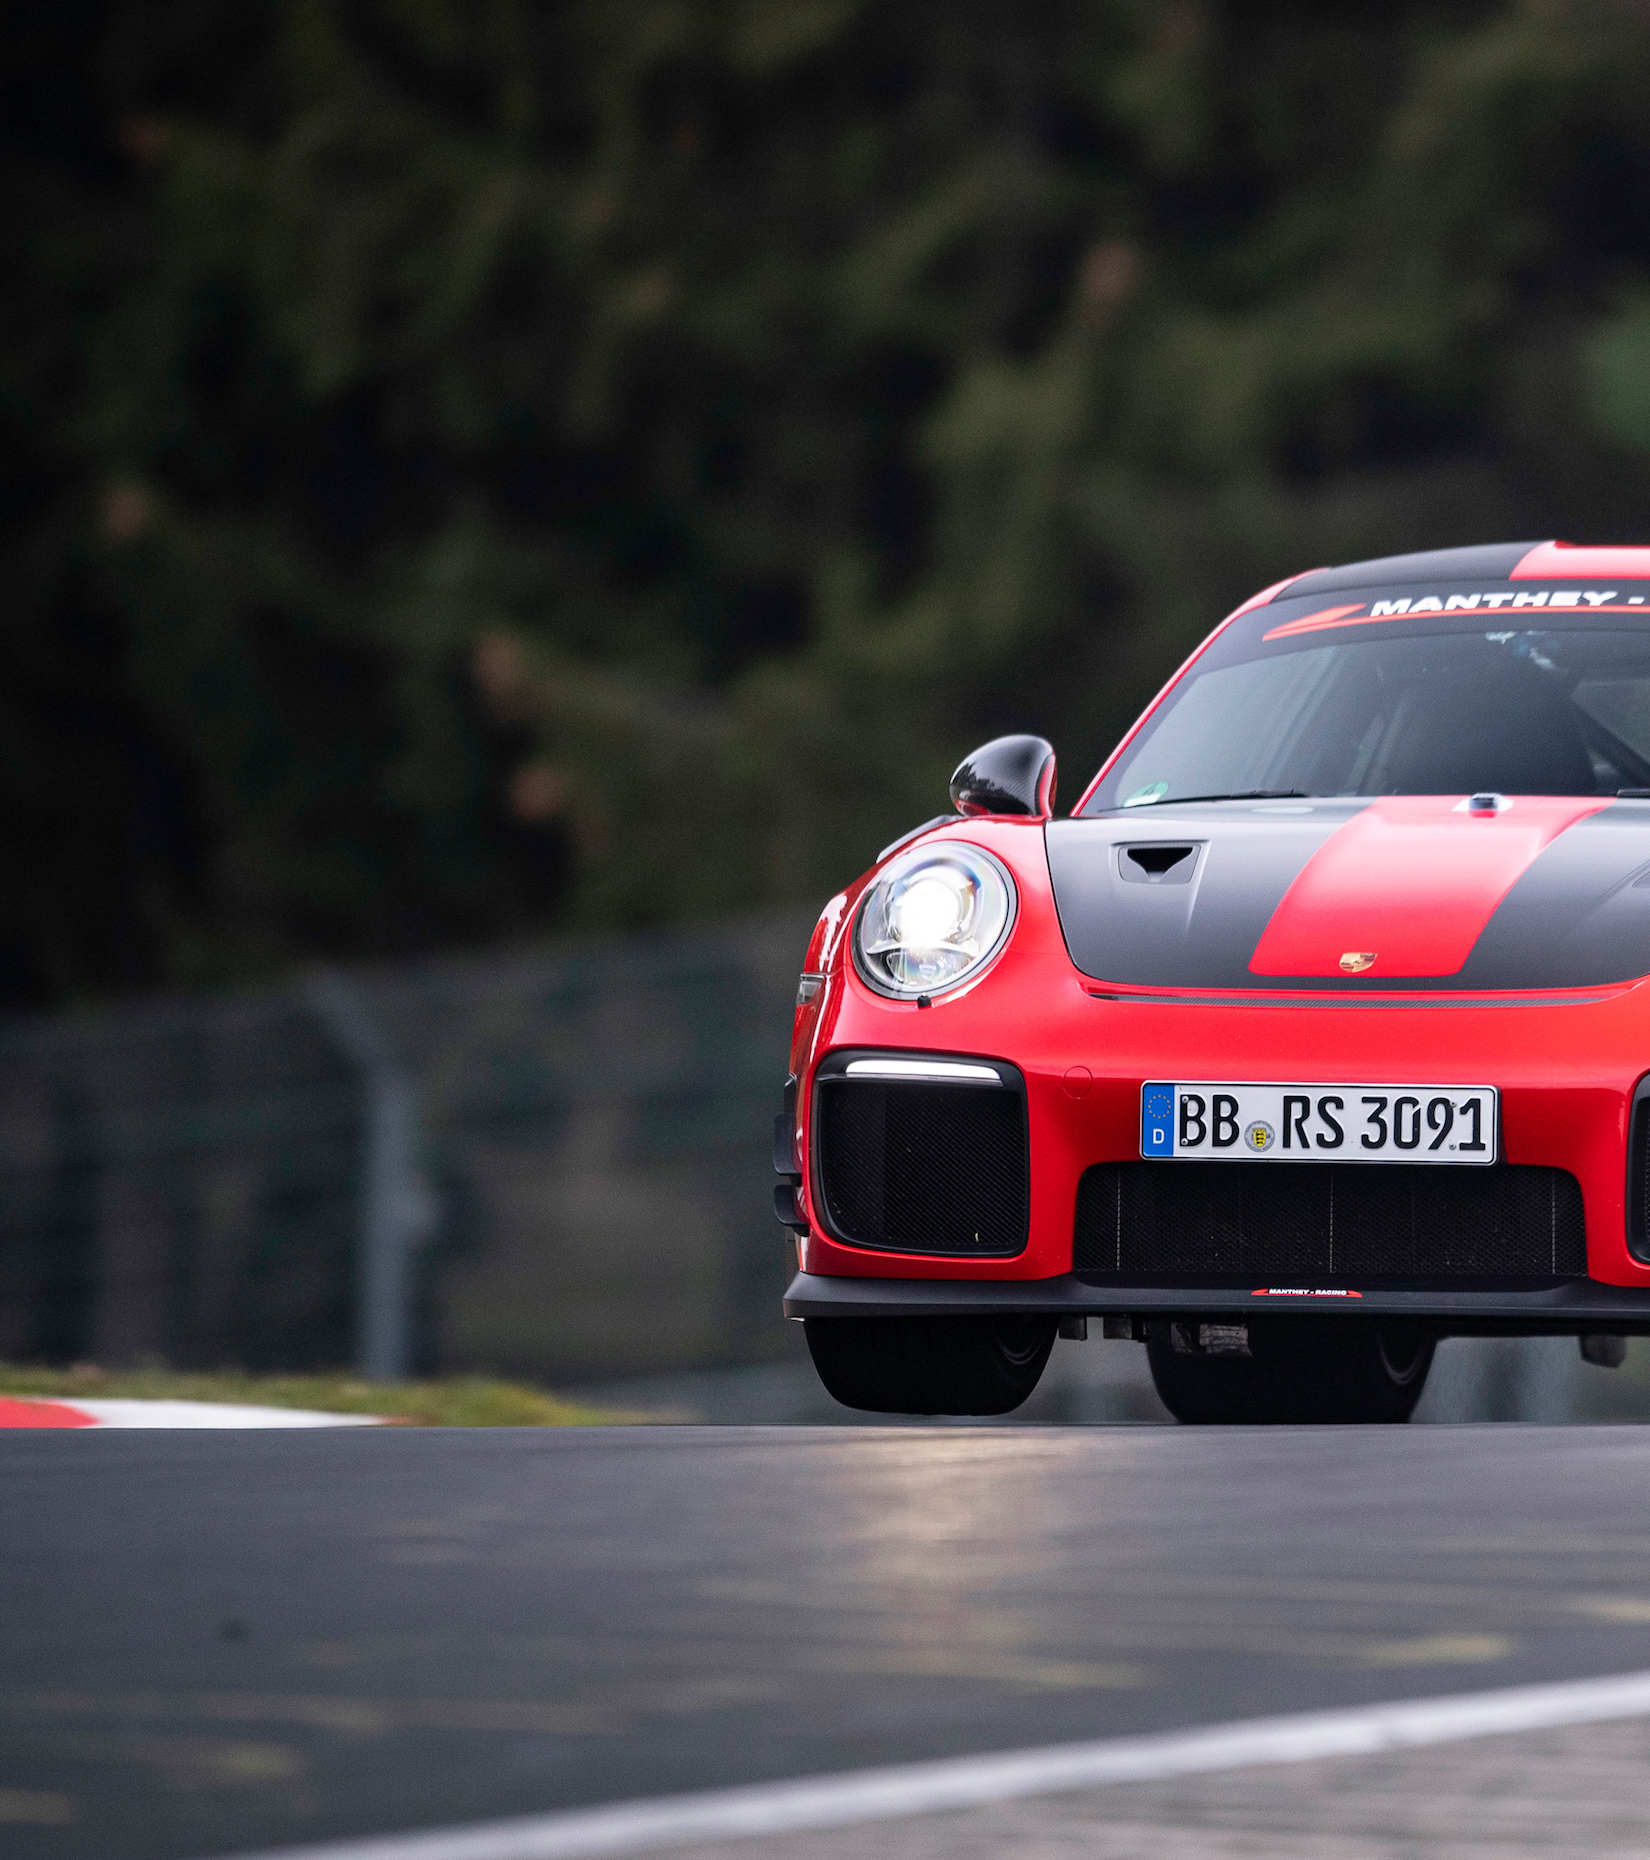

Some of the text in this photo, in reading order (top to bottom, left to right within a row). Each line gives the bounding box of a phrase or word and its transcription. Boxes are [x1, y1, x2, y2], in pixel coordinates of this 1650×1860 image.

[1370, 590, 1619, 617] MANTHEY
[1179, 1093, 1240, 1148] BB
[1282, 1095, 1345, 1150] RS
[1360, 1096, 1486, 1151] 3091
[1152, 1128, 1165, 1145] D
